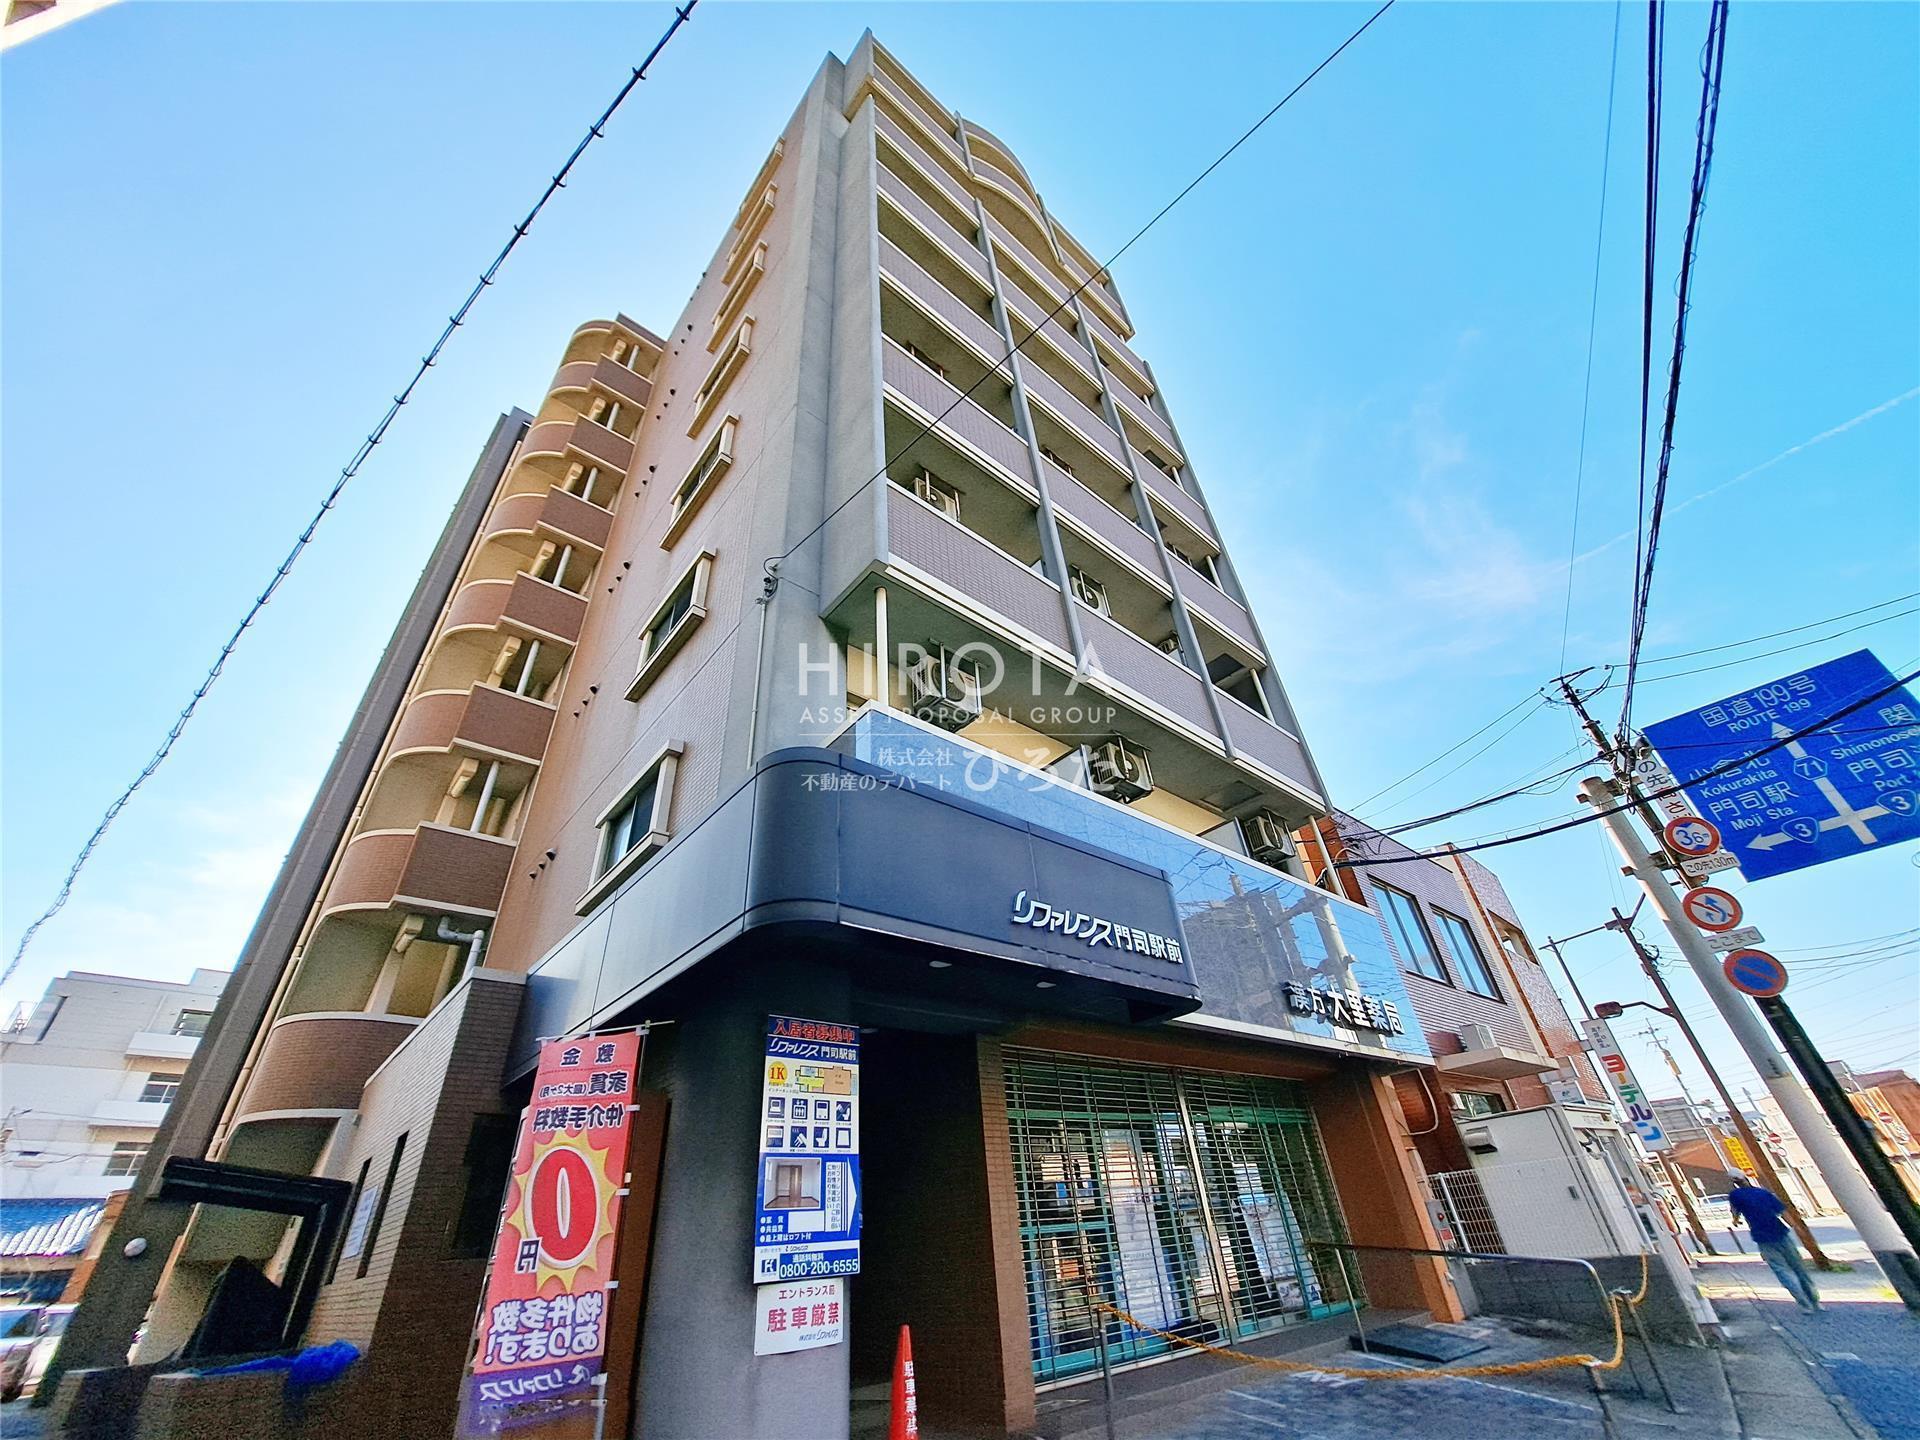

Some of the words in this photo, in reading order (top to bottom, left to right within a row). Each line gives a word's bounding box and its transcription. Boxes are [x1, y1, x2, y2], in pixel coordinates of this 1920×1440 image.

[1700, 675, 1816, 727] 国道199号
[1727, 709, 1781, 733] ROUTE
[1782, 698, 1811, 713] 199
[1797, 761, 1824, 776] 71
[1846, 745, 1920, 782] 門司
[1700, 768, 1778, 798] Kokurakita
[1873, 774, 1912, 791] Port
[1709, 781, 1799, 822] 門司駅
[1891, 796, 1911, 810] 3
[1730, 813, 1763, 831] Moji
[1767, 806, 1798, 821] Sta.
[1794, 823, 1812, 837] 3
[1685, 855, 1737, 873] この先130m
[1708, 930, 1758, 949] ここまで
[774, 1019, 855, 1043] 入居者募集中
[770, 1067, 785, 1080] 1K
[780, 1258, 858, 1278] 0800-200-6555
[767, 1302, 839, 1332] 駐車厳禁
